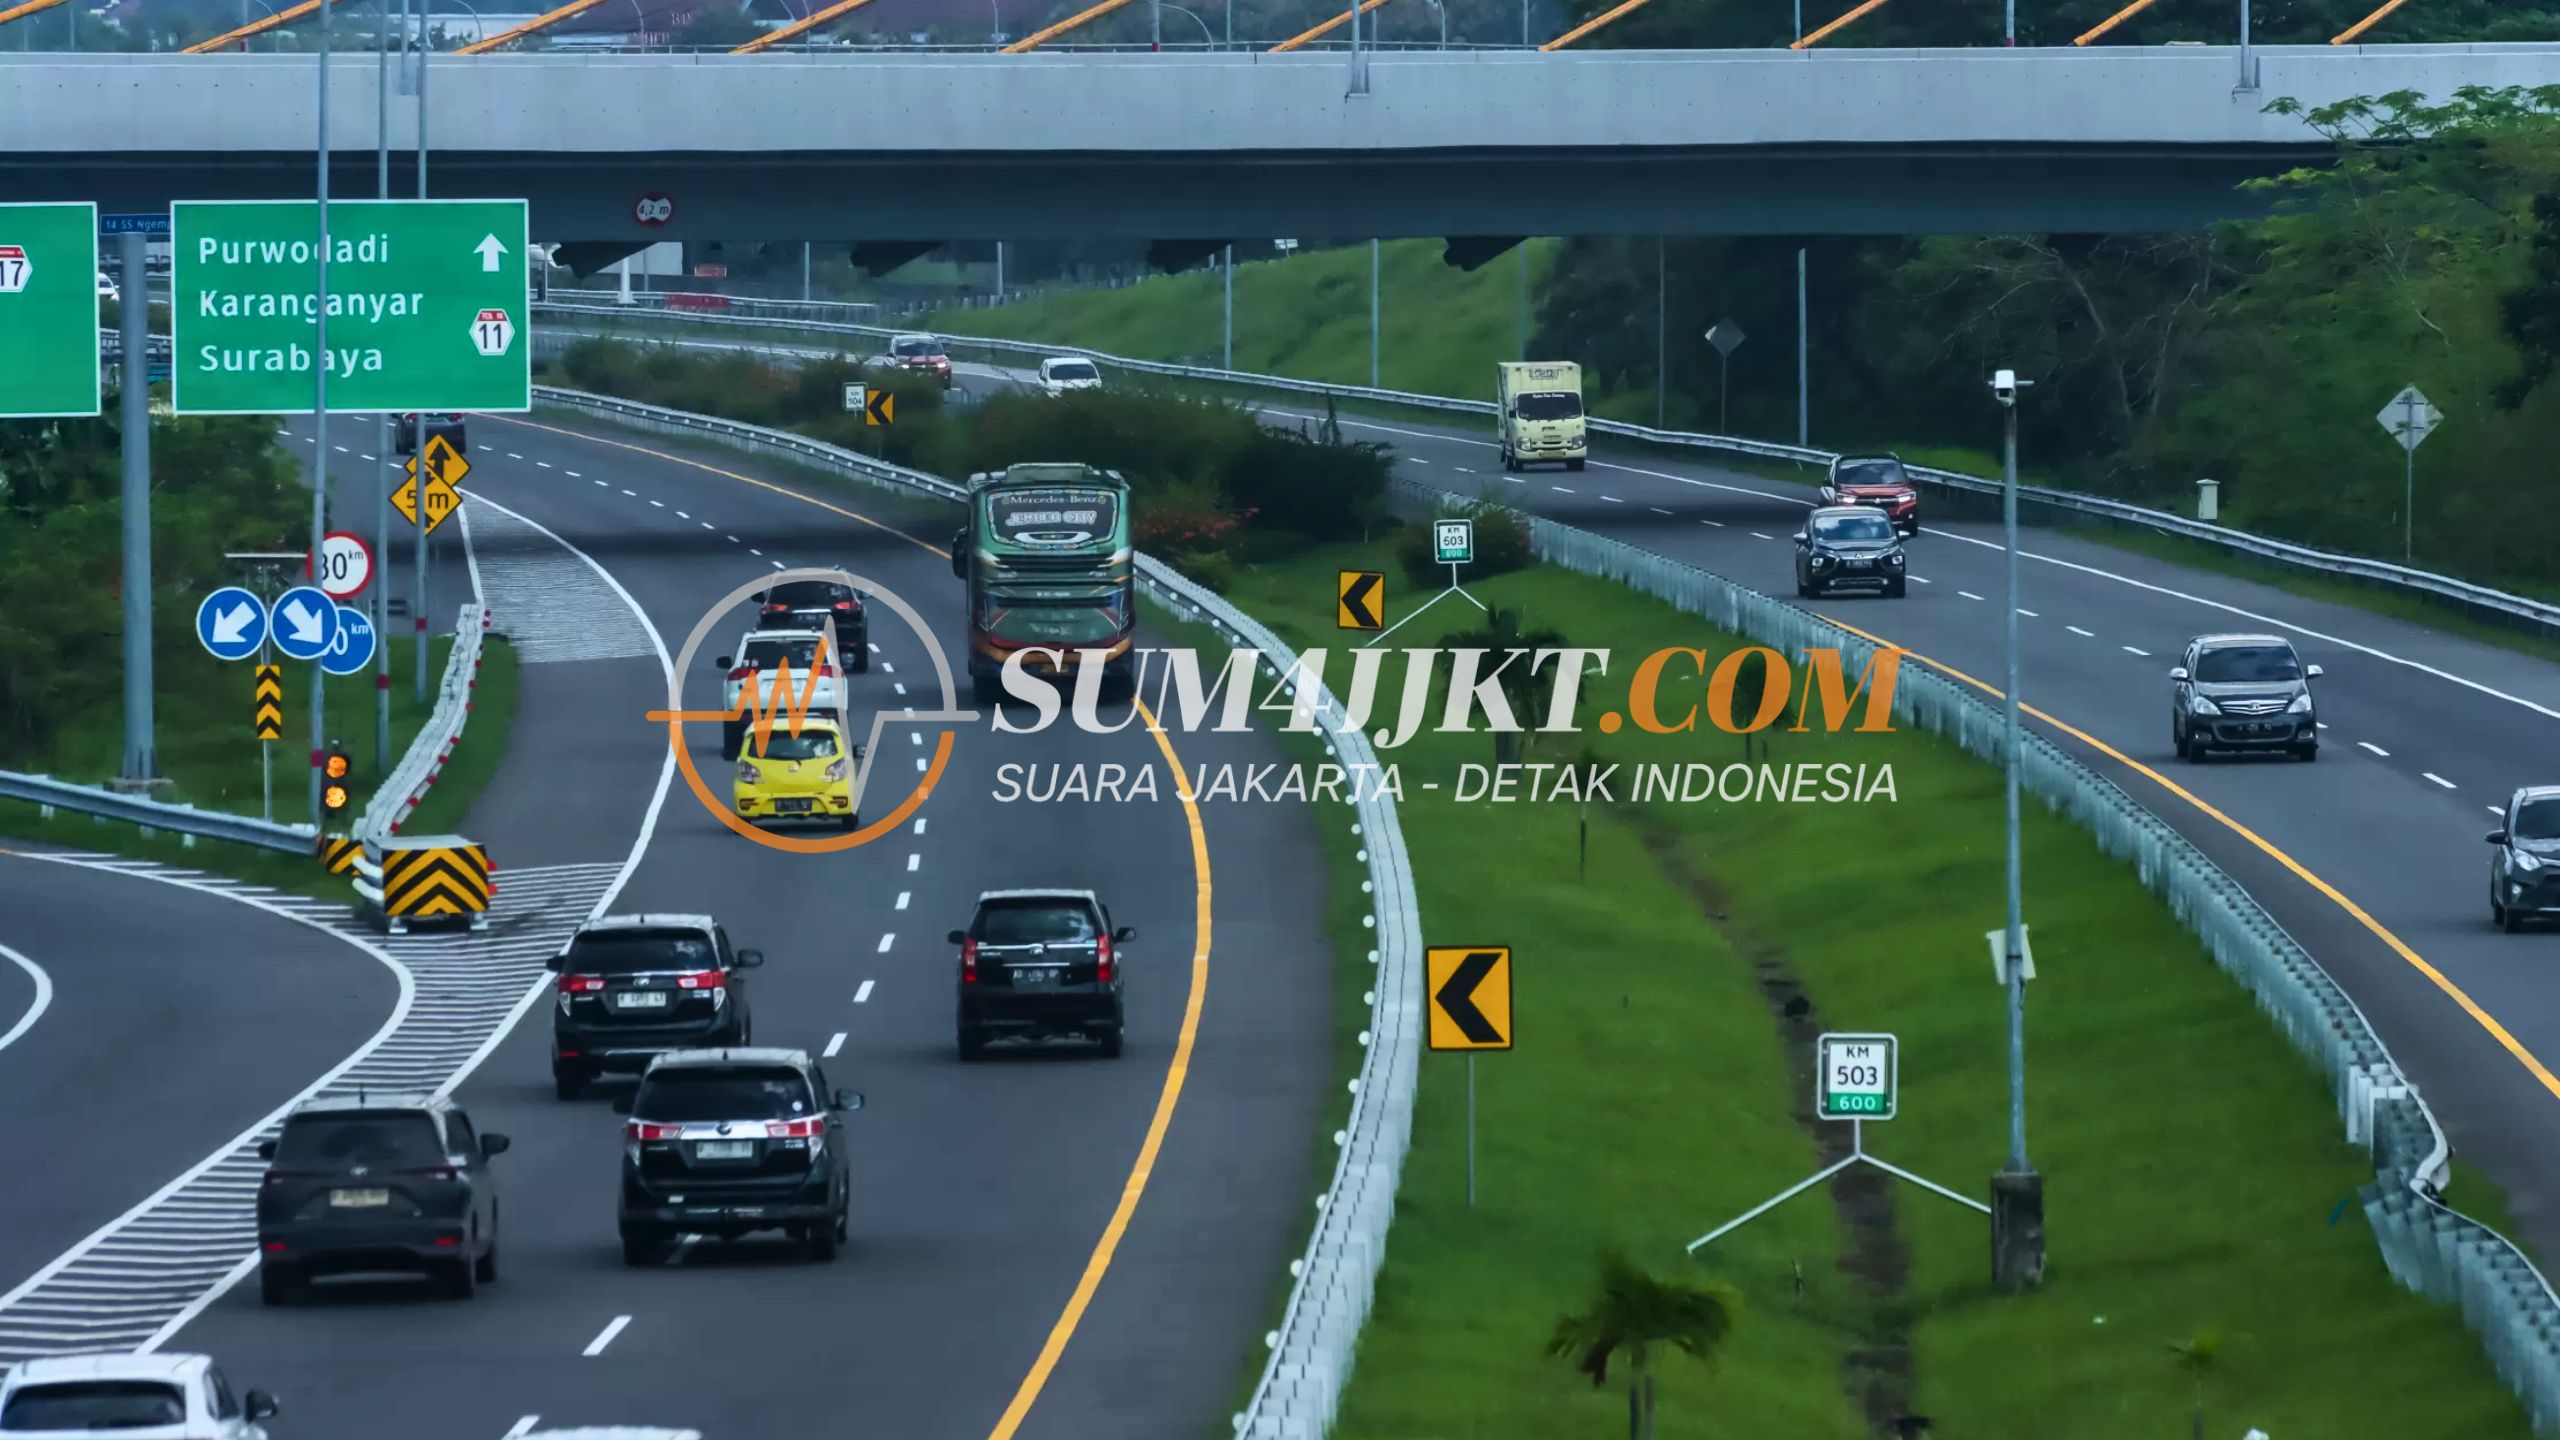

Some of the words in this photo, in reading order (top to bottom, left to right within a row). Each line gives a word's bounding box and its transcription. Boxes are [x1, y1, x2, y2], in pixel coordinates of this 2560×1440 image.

[200, 233, 388, 264] Purwodadi
[200, 290, 423, 323] Karanganyar
[479, 323, 502, 349] 11
[200, 343, 382, 378] Surabaya
[428, 492, 449, 509] m
[1010, 494, 1098, 505] Mercedes-Benz
[1447, 526, 1460, 534] KM
[1443, 535, 1464, 546] 503
[348, 550, 364, 560] km
[351, 623, 370, 635] km
[1846, 1046, 1869, 1058] KM
[1837, 1065, 1878, 1086] 503
[1839, 1096, 1876, 1111] 600
